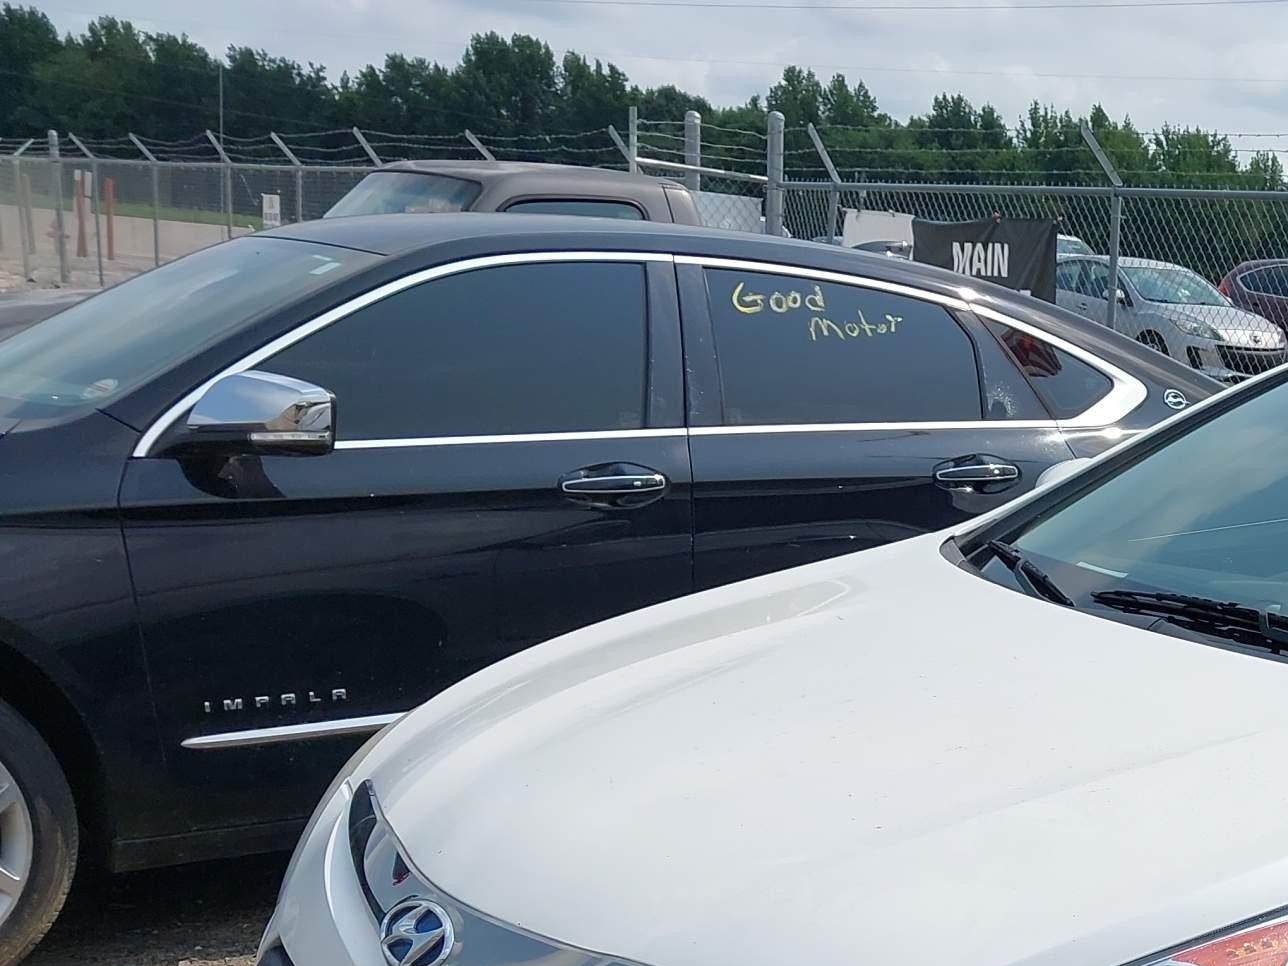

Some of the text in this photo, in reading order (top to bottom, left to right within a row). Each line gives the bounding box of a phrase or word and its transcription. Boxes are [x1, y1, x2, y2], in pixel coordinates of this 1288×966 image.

[952, 242, 1009, 278] MAIN
[732, 281, 825, 314] Good
[203, 687, 348, 713] IMPALA
